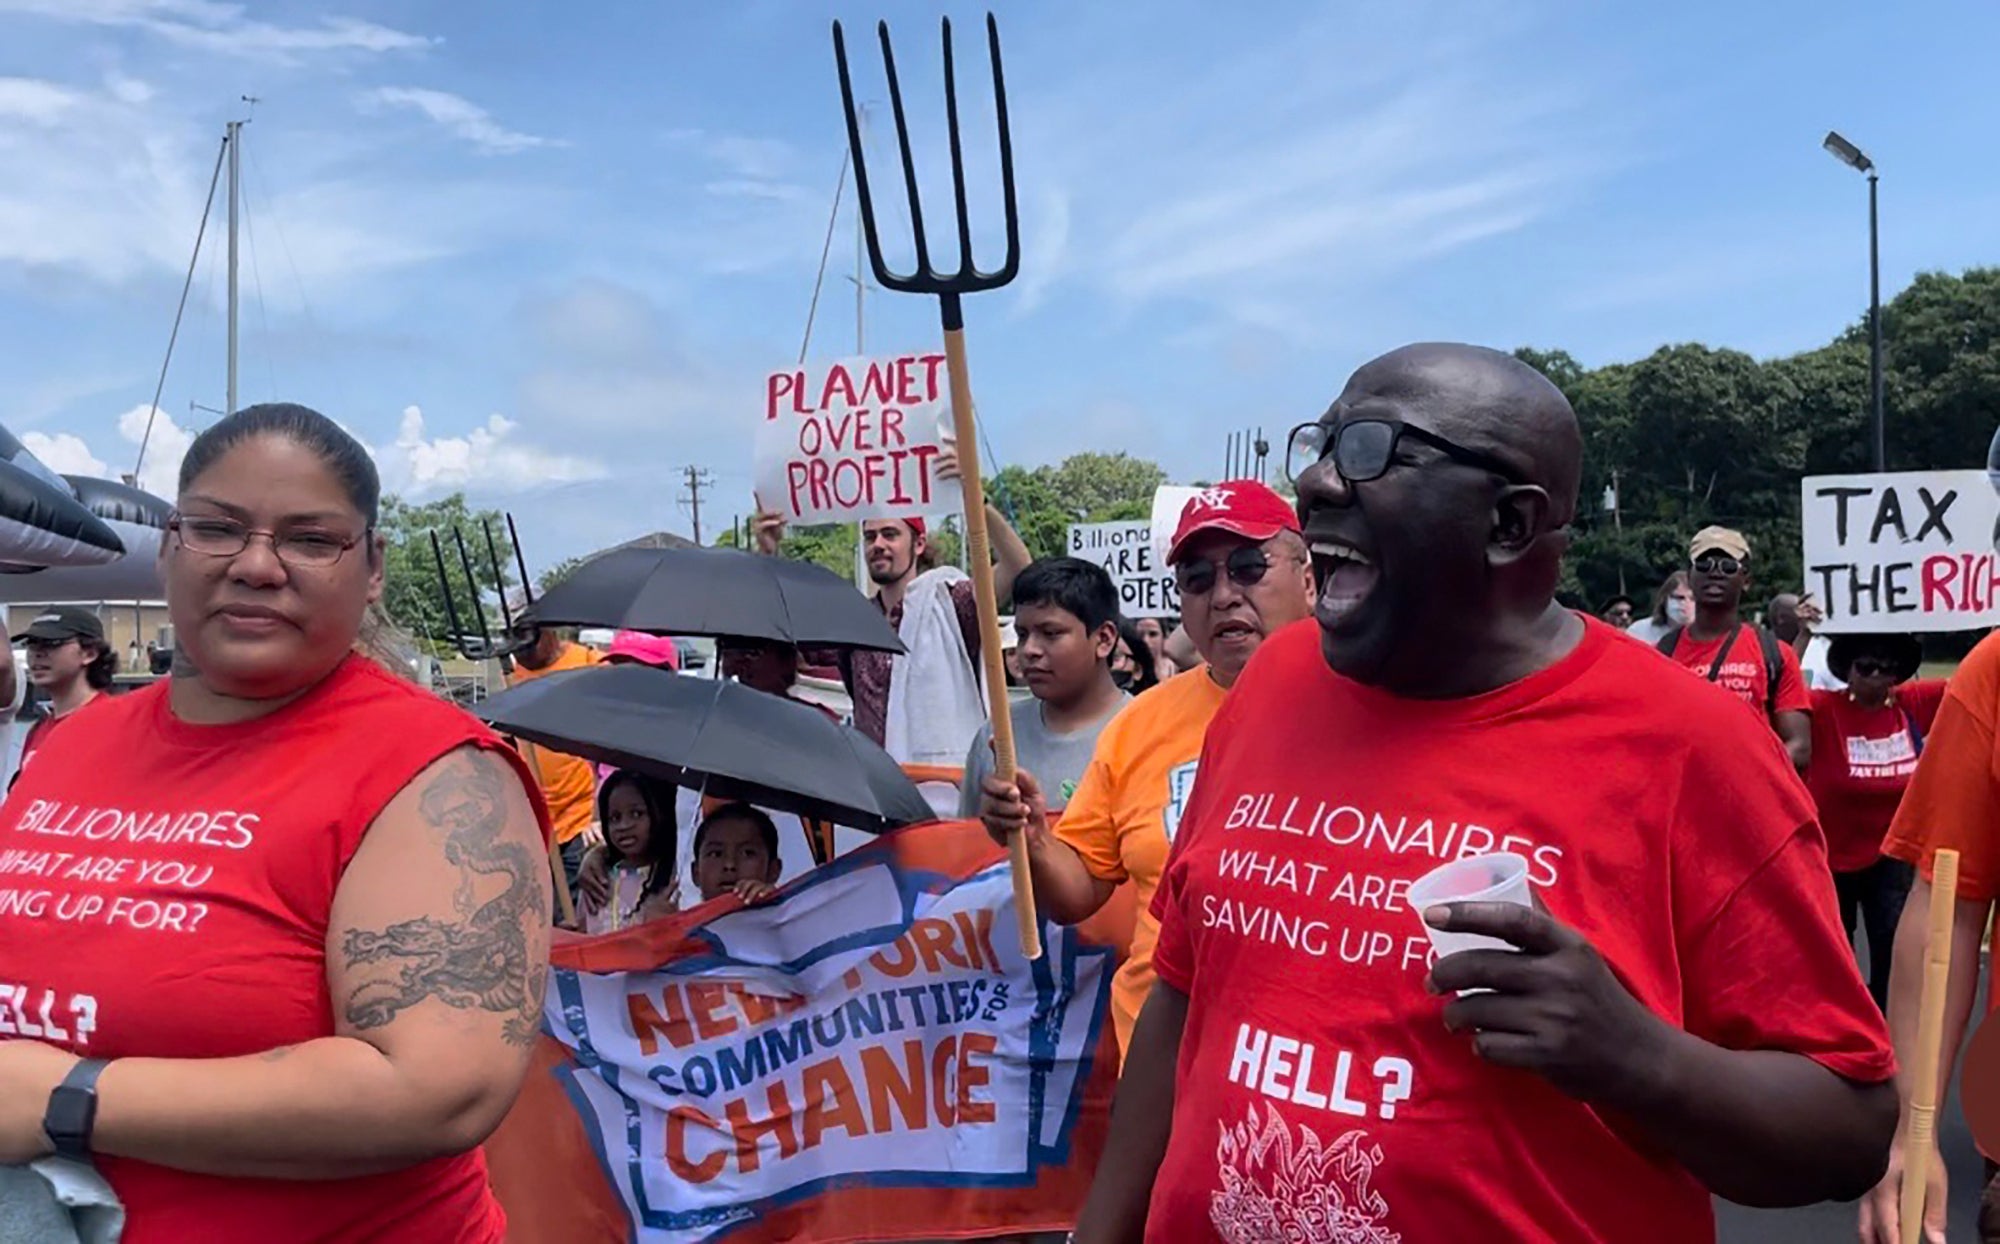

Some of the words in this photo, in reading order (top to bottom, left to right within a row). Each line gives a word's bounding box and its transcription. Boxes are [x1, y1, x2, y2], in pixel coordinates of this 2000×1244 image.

[767, 355, 946, 420] PLANET
[800, 408, 906, 456] OVER
[788, 446, 939, 517] PROFIT
[1191, 488, 1236, 515] NY
[1816, 486, 1958, 546] TAX
[1104, 546, 1151, 575] ARE
[1810, 562, 1917, 620] THE
[16, 800, 260, 849] BILLIONAIRES
[64, 857, 134, 882] ARE
[137, 863, 214, 888] YOU
[1218, 849, 1327, 896] WHAT
[1330, 873, 1411, 912] ARE
[56, 893, 103, 921] UP
[106, 898, 208, 932] FOR?
[1202, 895, 1328, 956] SAVING
[1339, 928, 1393, 967] UP
[843, 908, 1006, 990] ORK
[982, 983, 1010, 1022] FOR
[648, 979, 987, 1098] COMMUNITIES
[1228, 1023, 1413, 1120] HELL?
